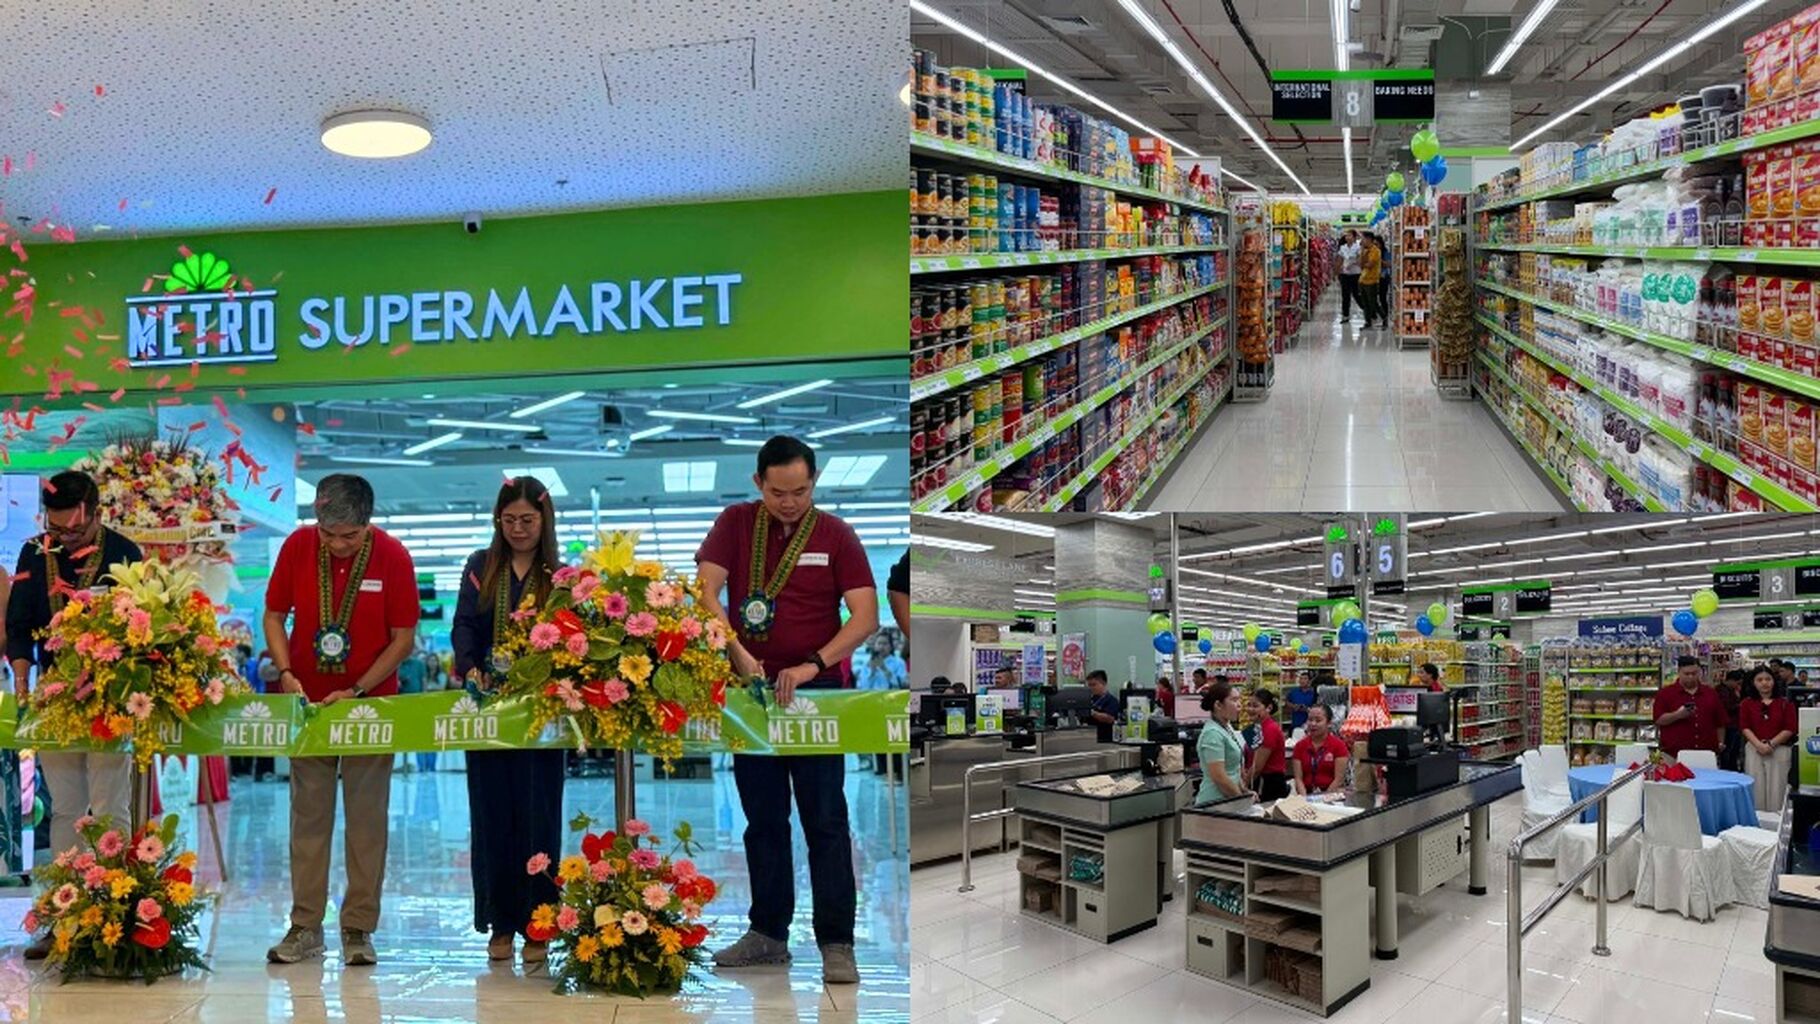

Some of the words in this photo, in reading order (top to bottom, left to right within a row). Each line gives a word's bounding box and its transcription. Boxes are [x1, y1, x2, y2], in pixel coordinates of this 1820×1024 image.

[1407, 86, 1434, 95] NEEDS
[1346, 92, 1360, 116] 8
[128, 300, 275, 358] METRO
[299, 273, 742, 349] SUPERMARKET
[1331, 552, 1344, 578] 6
[1379, 545, 1393, 573] 5
[1772, 576, 1783, 593] 3
[1501, 597, 1509, 611] 2
[1785, 614, 1799, 626] 12
[223, 723, 287, 745] METRO
[330, 723, 393, 744] METRO
[434, 716, 498, 741] METRO
[768, 718, 839, 743] METRO
